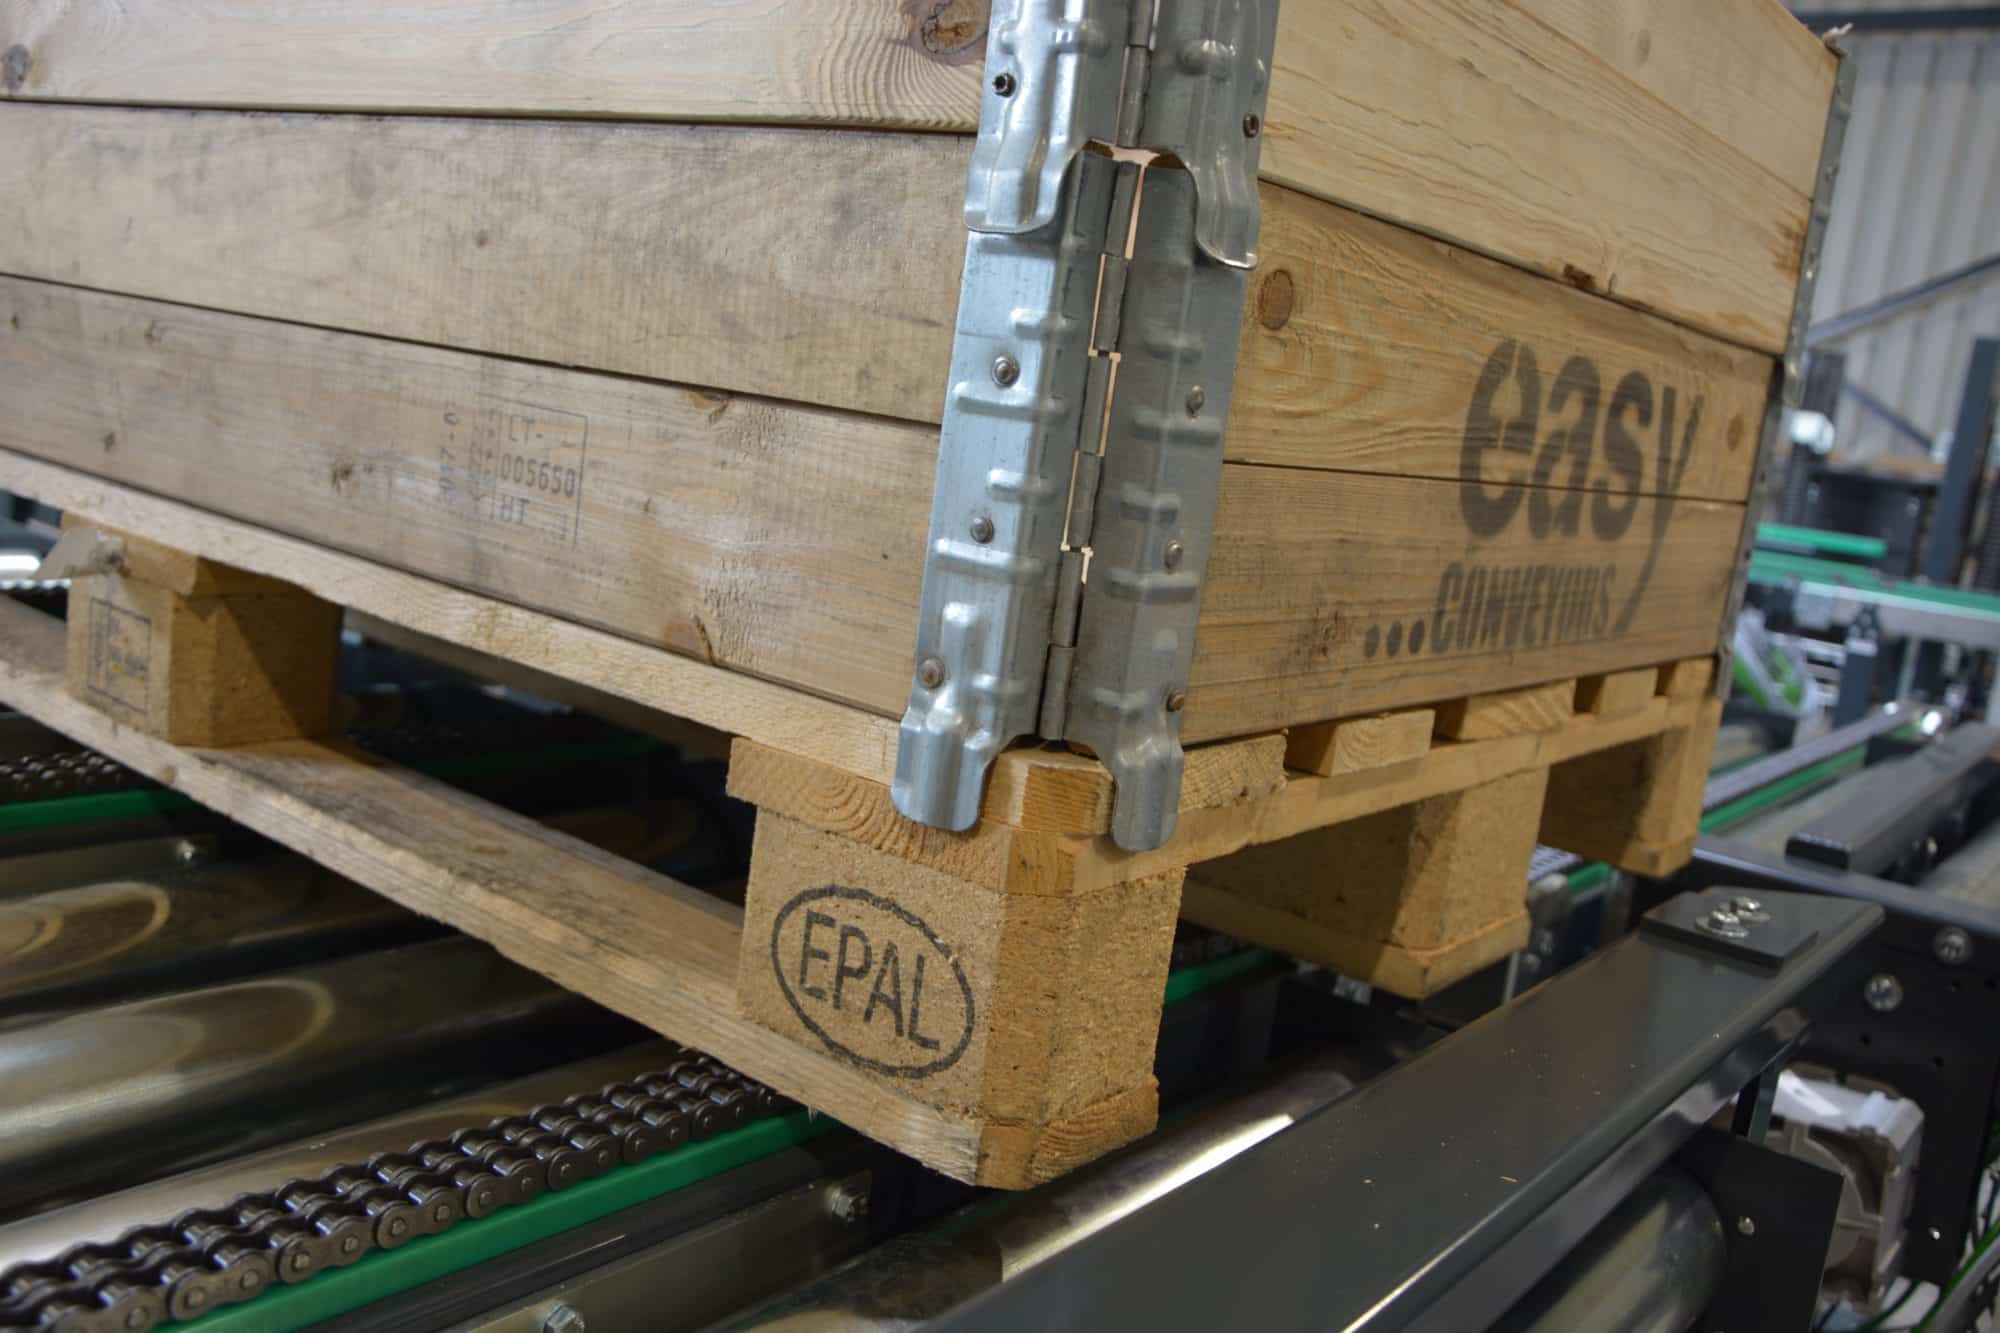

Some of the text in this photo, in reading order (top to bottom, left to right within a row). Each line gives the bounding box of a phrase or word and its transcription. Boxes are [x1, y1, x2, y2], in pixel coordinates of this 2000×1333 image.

[501, 452, 577, 499] 005650
[1459, 336, 1704, 634] easy
[800, 908, 941, 1051] EPAL
